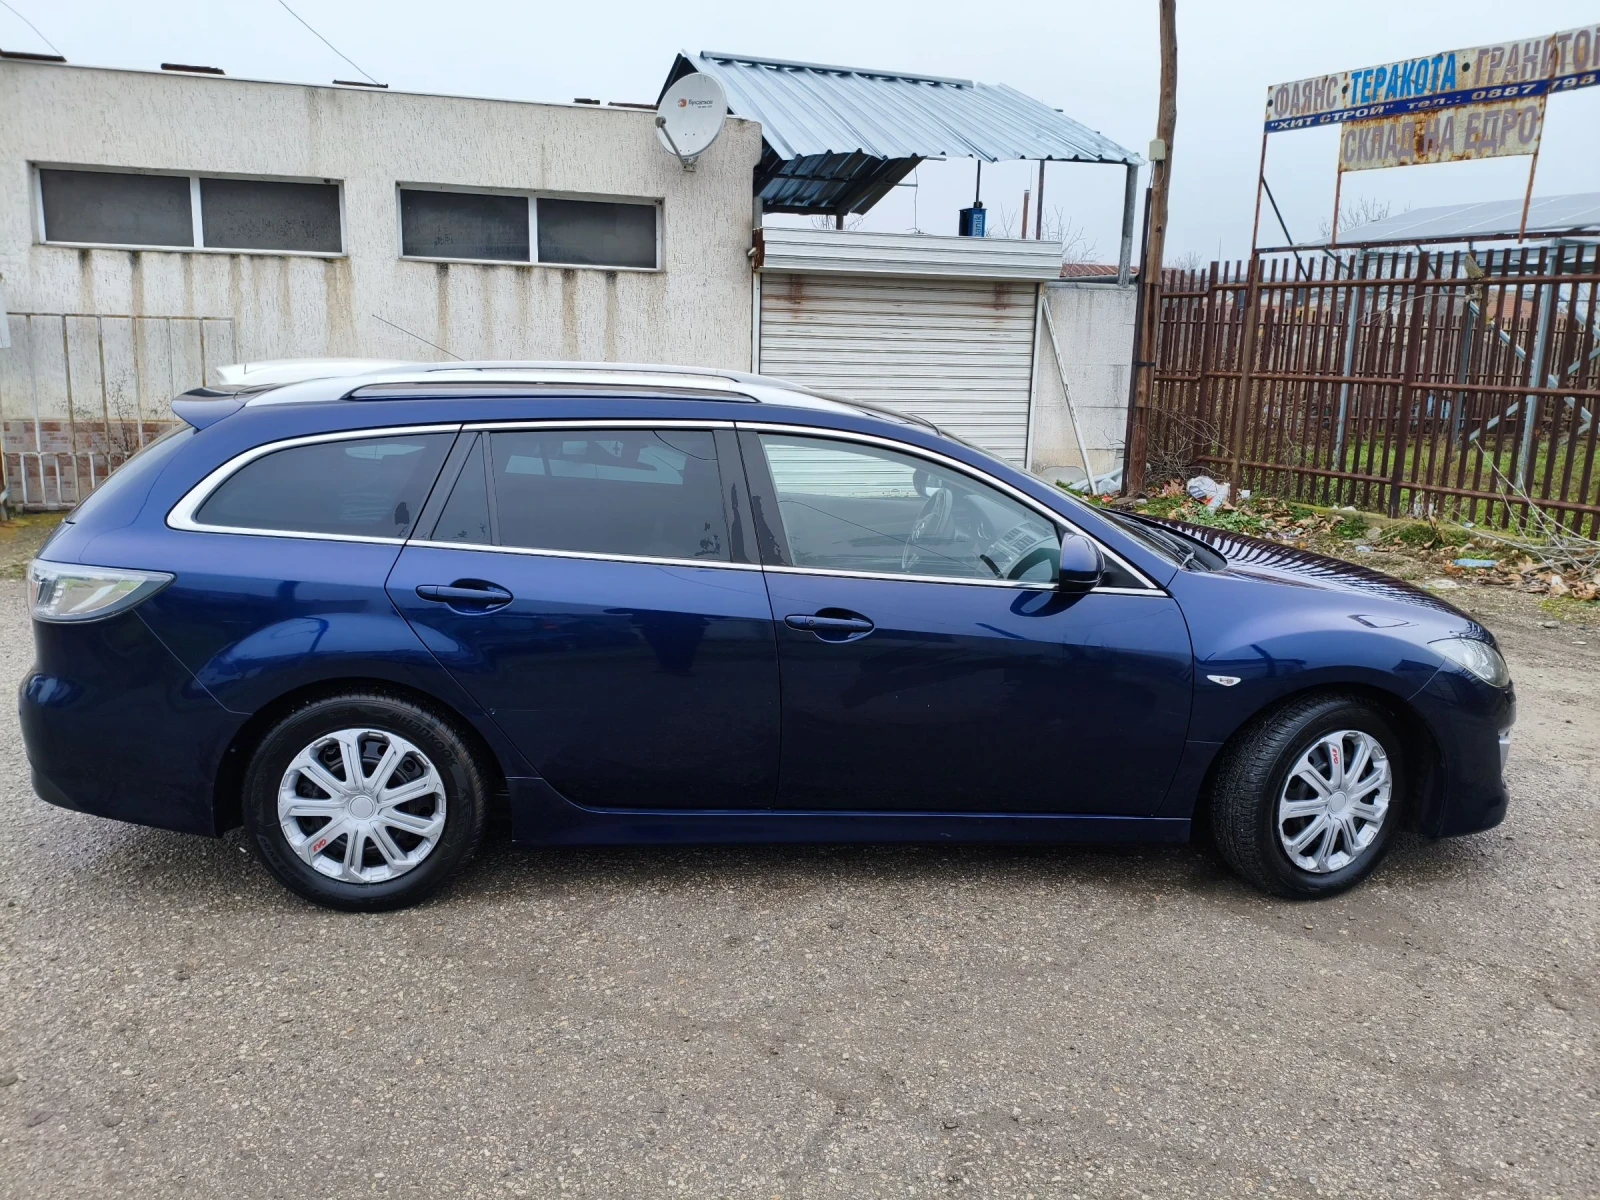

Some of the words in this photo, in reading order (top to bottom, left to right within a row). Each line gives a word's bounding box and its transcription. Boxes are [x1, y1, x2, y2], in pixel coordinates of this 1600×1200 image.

[1274, 76, 1338, 118] ФАЯНС
[1350, 52, 1456, 105] ТЕРАКОТА
[1471, 83, 1538, 100] 0887
[1551, 73, 1597, 90] 798
[1344, 121, 1415, 163] СКЛАД
[1423, 115, 1455, 155] НА
[1464, 105, 1539, 154] ЕДРО
[313, 839, 327, 853] EVO
